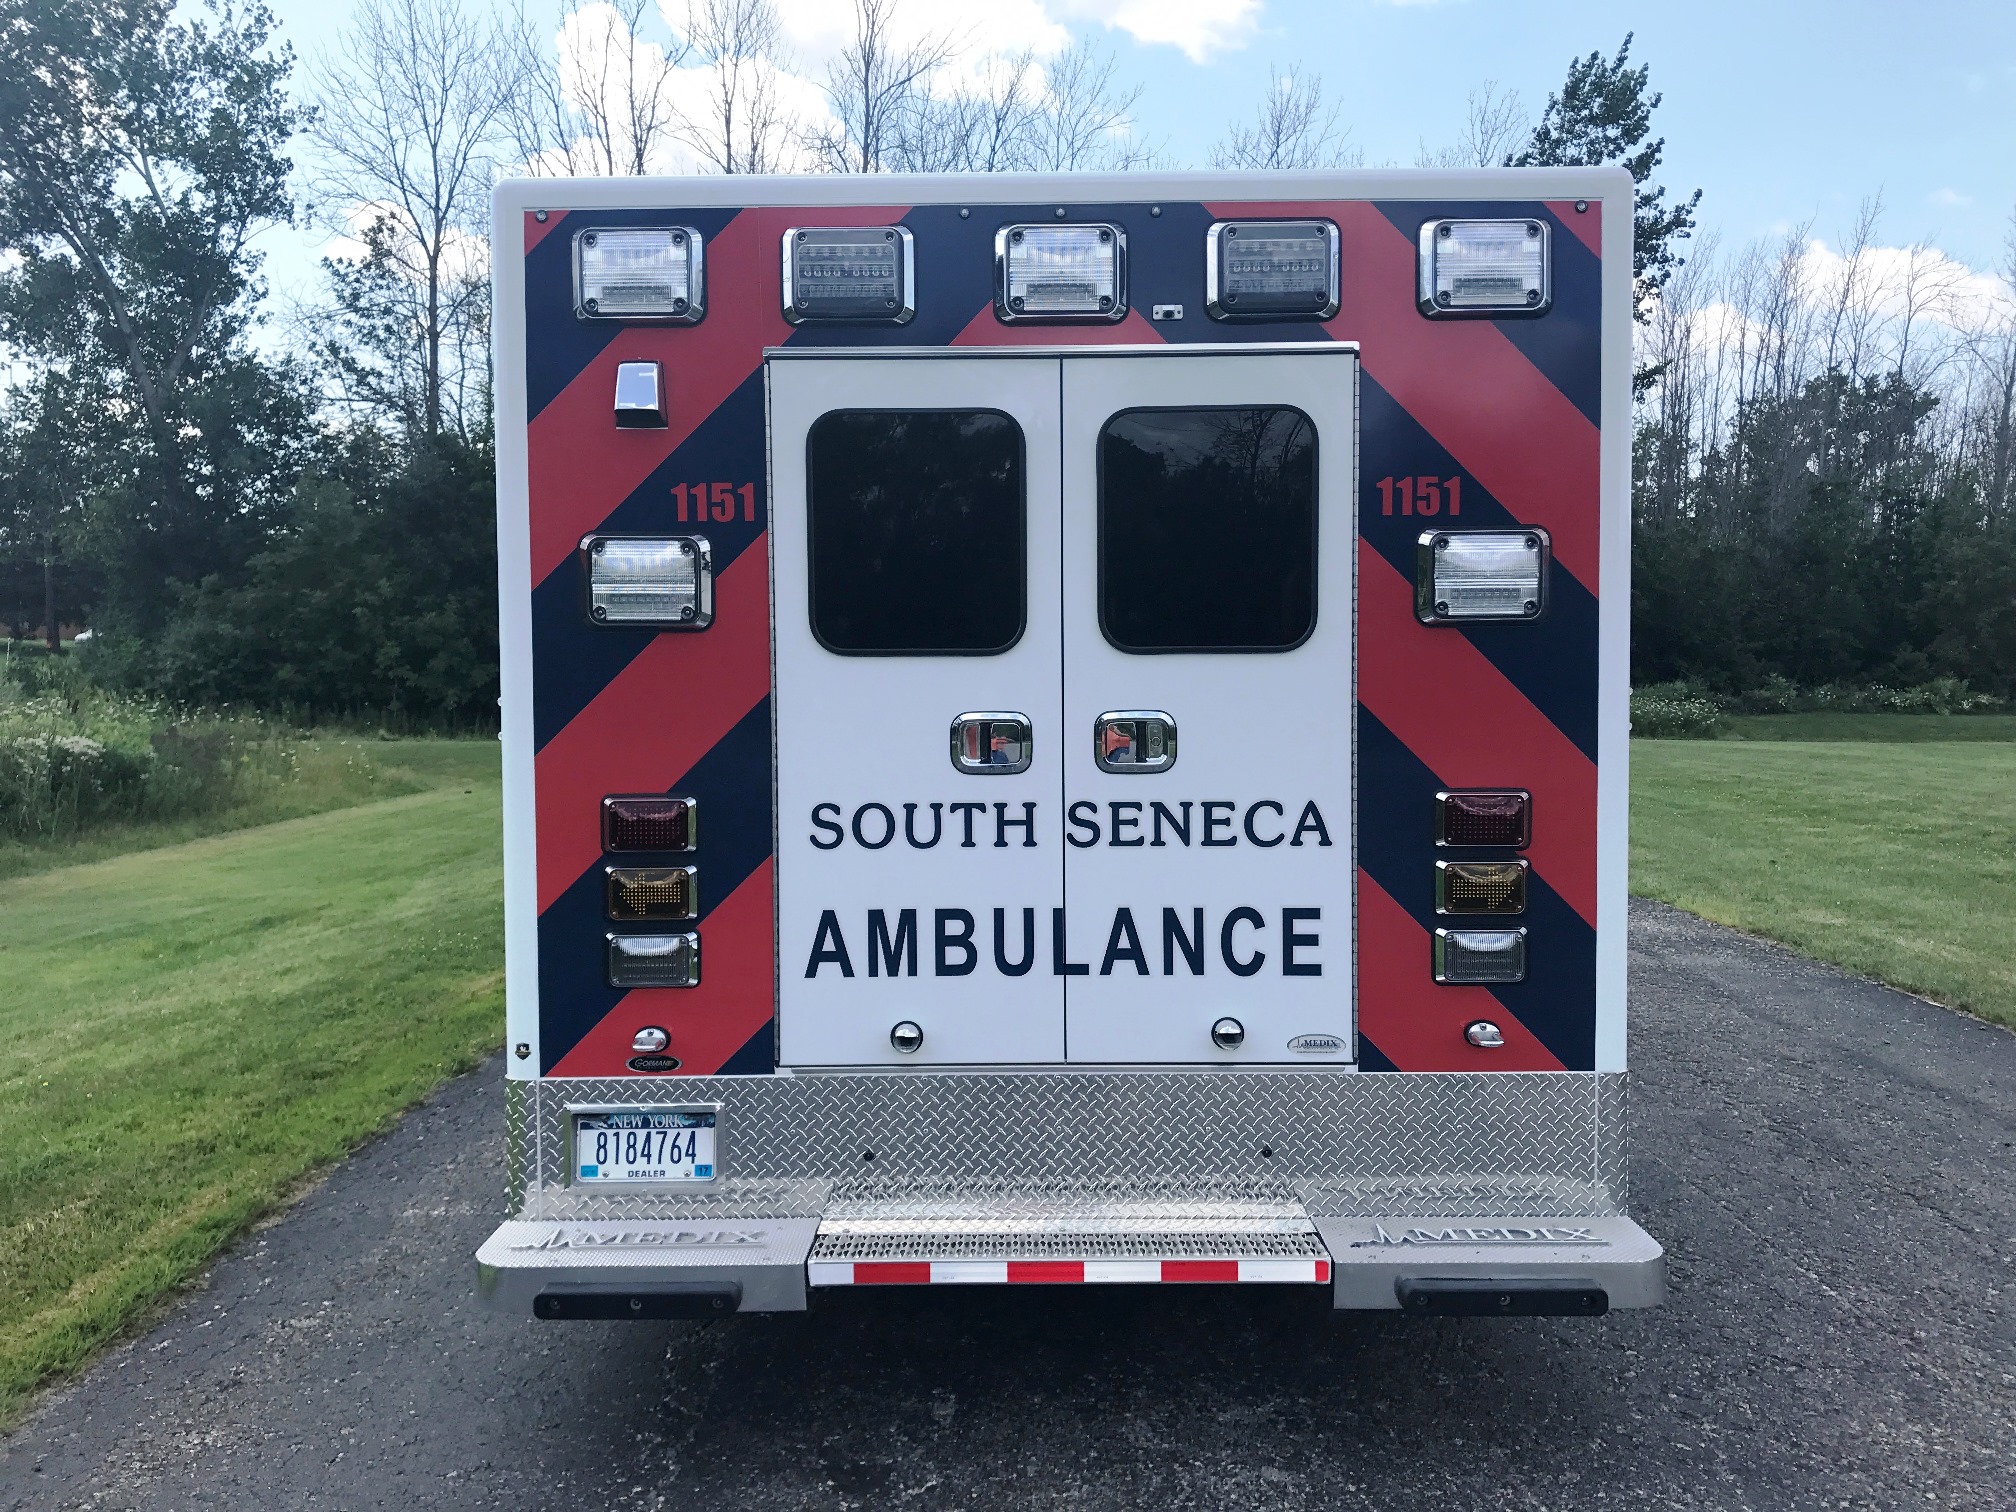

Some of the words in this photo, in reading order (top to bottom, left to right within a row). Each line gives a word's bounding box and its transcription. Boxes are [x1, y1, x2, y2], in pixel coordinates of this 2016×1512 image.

[670, 482, 755, 522] 1151
[1376, 476, 1461, 516] 1151
[809, 802, 1038, 850] SOUTH
[1066, 800, 1333, 848] SENECA
[804, 906, 1323, 979] AMBULANCE
[1303, 1039, 1338, 1047] MEDIX
[612, 1115, 643, 1128] NEW
[649, 1115, 684, 1128] YORK
[596, 1130, 697, 1165] 8184764
[627, 1170, 666, 1178] DEALER
[578, 1230, 768, 1246] MEDIX
[1410, 1227, 1600, 1242] MEDIX
